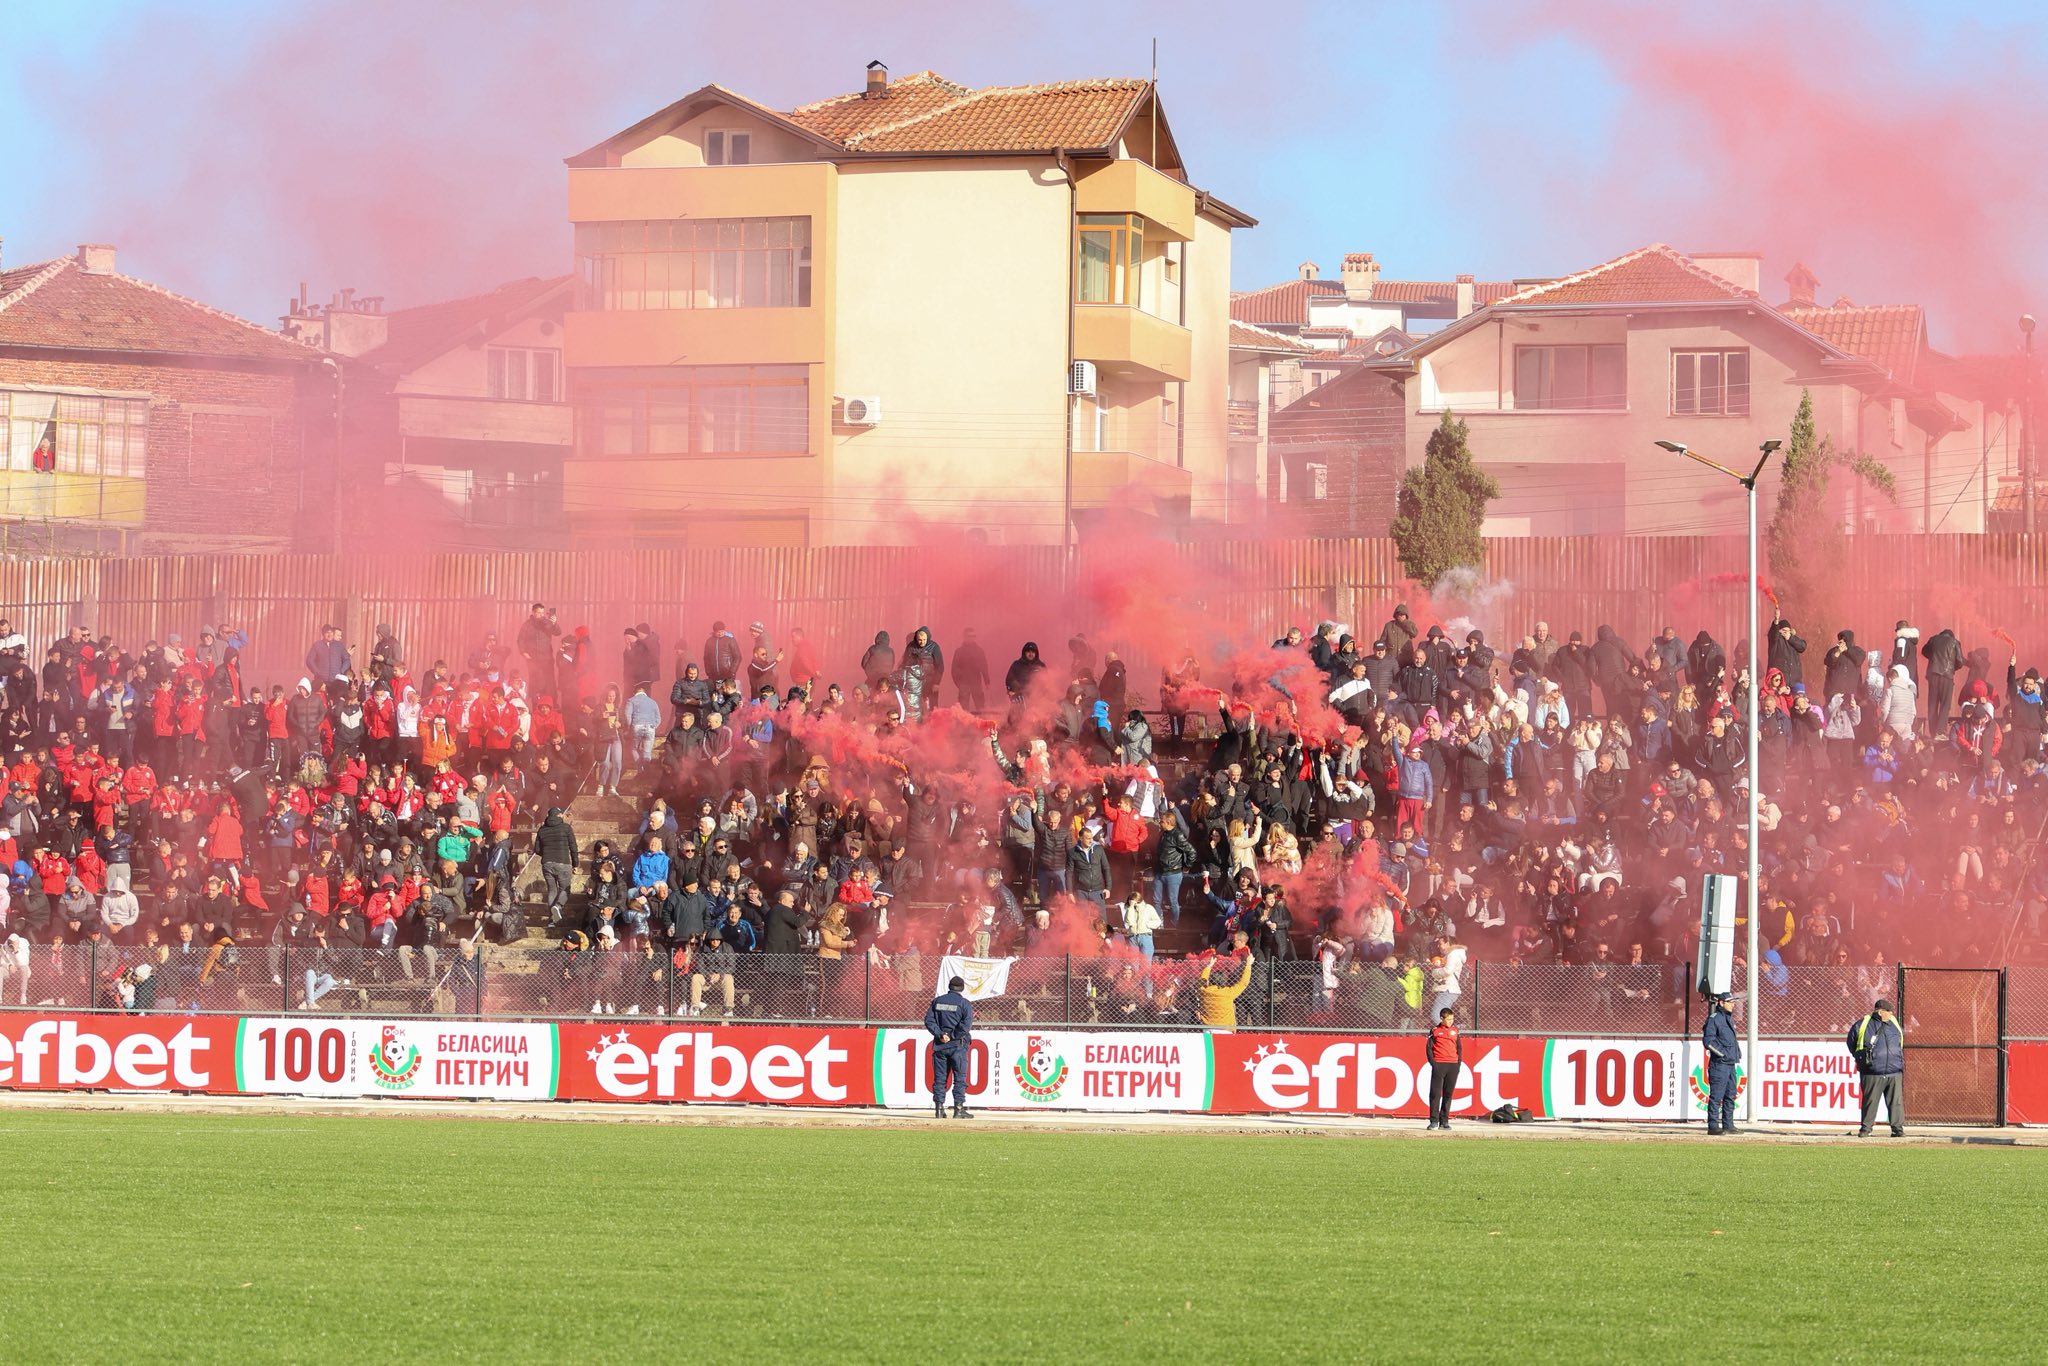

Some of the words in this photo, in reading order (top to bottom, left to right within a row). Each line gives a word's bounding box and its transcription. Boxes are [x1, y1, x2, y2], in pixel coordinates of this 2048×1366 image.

[259, 1028, 345, 1082] 100
[438, 1034, 528, 1056] БЕЛАСИЦА
[1029, 1038, 1052, 1047] ОФК
[1085, 1044, 1180, 1066] БЕЛАСИЦА
[436, 1060, 529, 1086] ПЕТРИЧ
[595, 1032, 847, 1100] efbet
[993, 1042, 1001, 1096] ГОДИНИ
[1568, 1049, 1663, 1108] 100
[1764, 1054, 1860, 1078] БЕЛАСИЦ
[1083, 1071, 1181, 1098] ПЕТРИЧ
